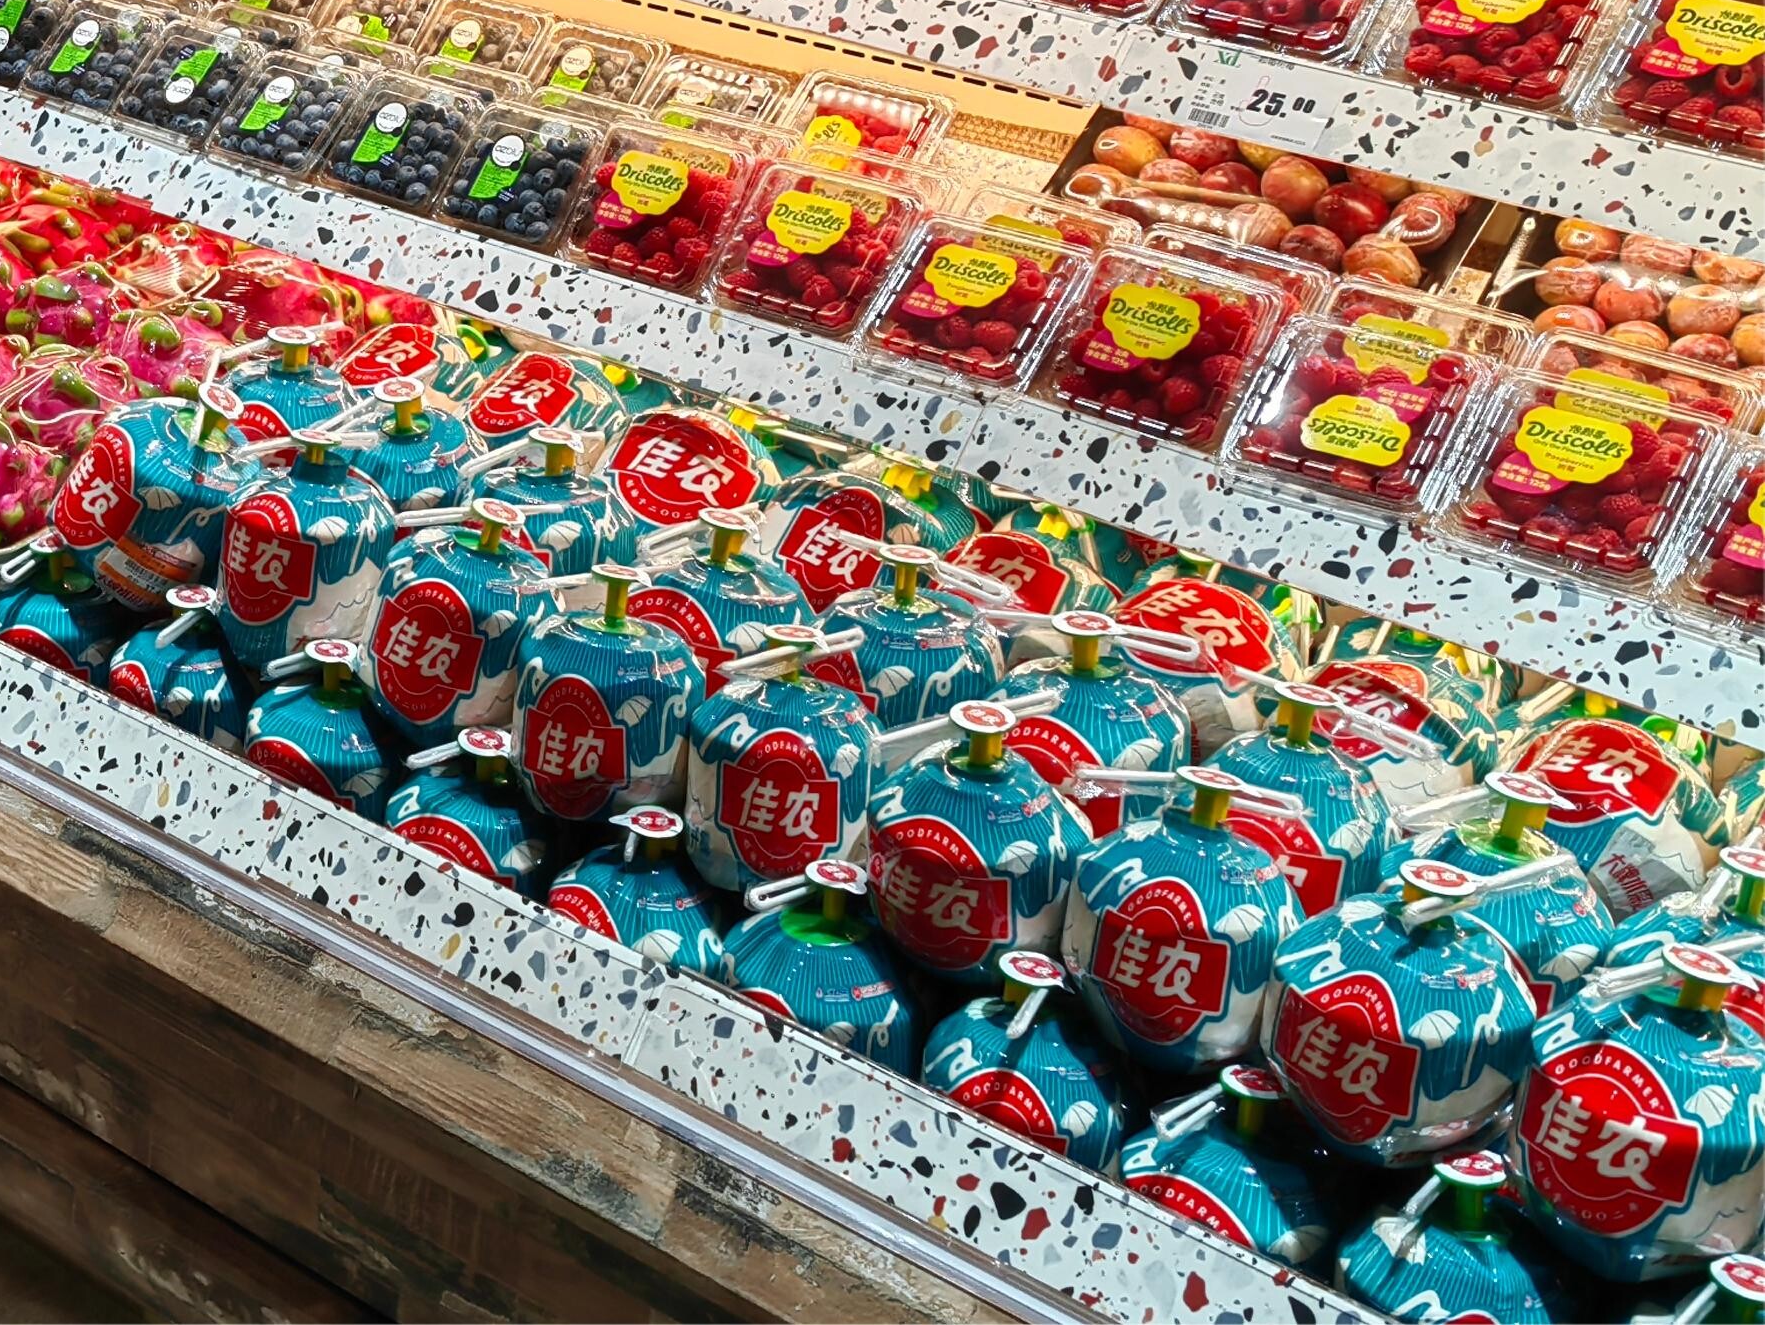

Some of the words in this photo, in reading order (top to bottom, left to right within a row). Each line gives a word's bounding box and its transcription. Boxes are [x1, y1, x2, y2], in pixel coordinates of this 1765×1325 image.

[1247, 89, 1315, 117] 25.00
[620, 163, 684, 192] Driscoll's
[774, 203, 845, 232] Driscoll's
[936, 256, 1009, 286] Driscoll's
[1110, 297, 1193, 335] Driscoll's
[1525, 421, 1629, 459] Driscoll's
[626, 434, 734, 507] 佳农
[229, 521, 290, 591] 佳农
[401, 589, 465, 629] GOODFARMER
[1142, 584, 1248, 655] 佳农
[384, 615, 460, 684] 佳农
[538, 719, 605, 780] 佳农
[1539, 735, 1650, 797] 佳农
[739, 776, 820, 839] 佳农
[401, 826, 481, 869] GOODFARMER
[880, 853, 980, 935] 佳农
[1127, 887, 1195, 931] GOODFARMER
[1108, 924, 1201, 1005] 佳农
[1320, 983, 1391, 1033] GOODFARMER
[1296, 1015, 1389, 1106] 佳农
[1554, 1053, 1660, 1111] GOODFARMER
[962, 1083, 1046, 1128] GOODFARMER
[1535, 1088, 1667, 1192] 佳农
